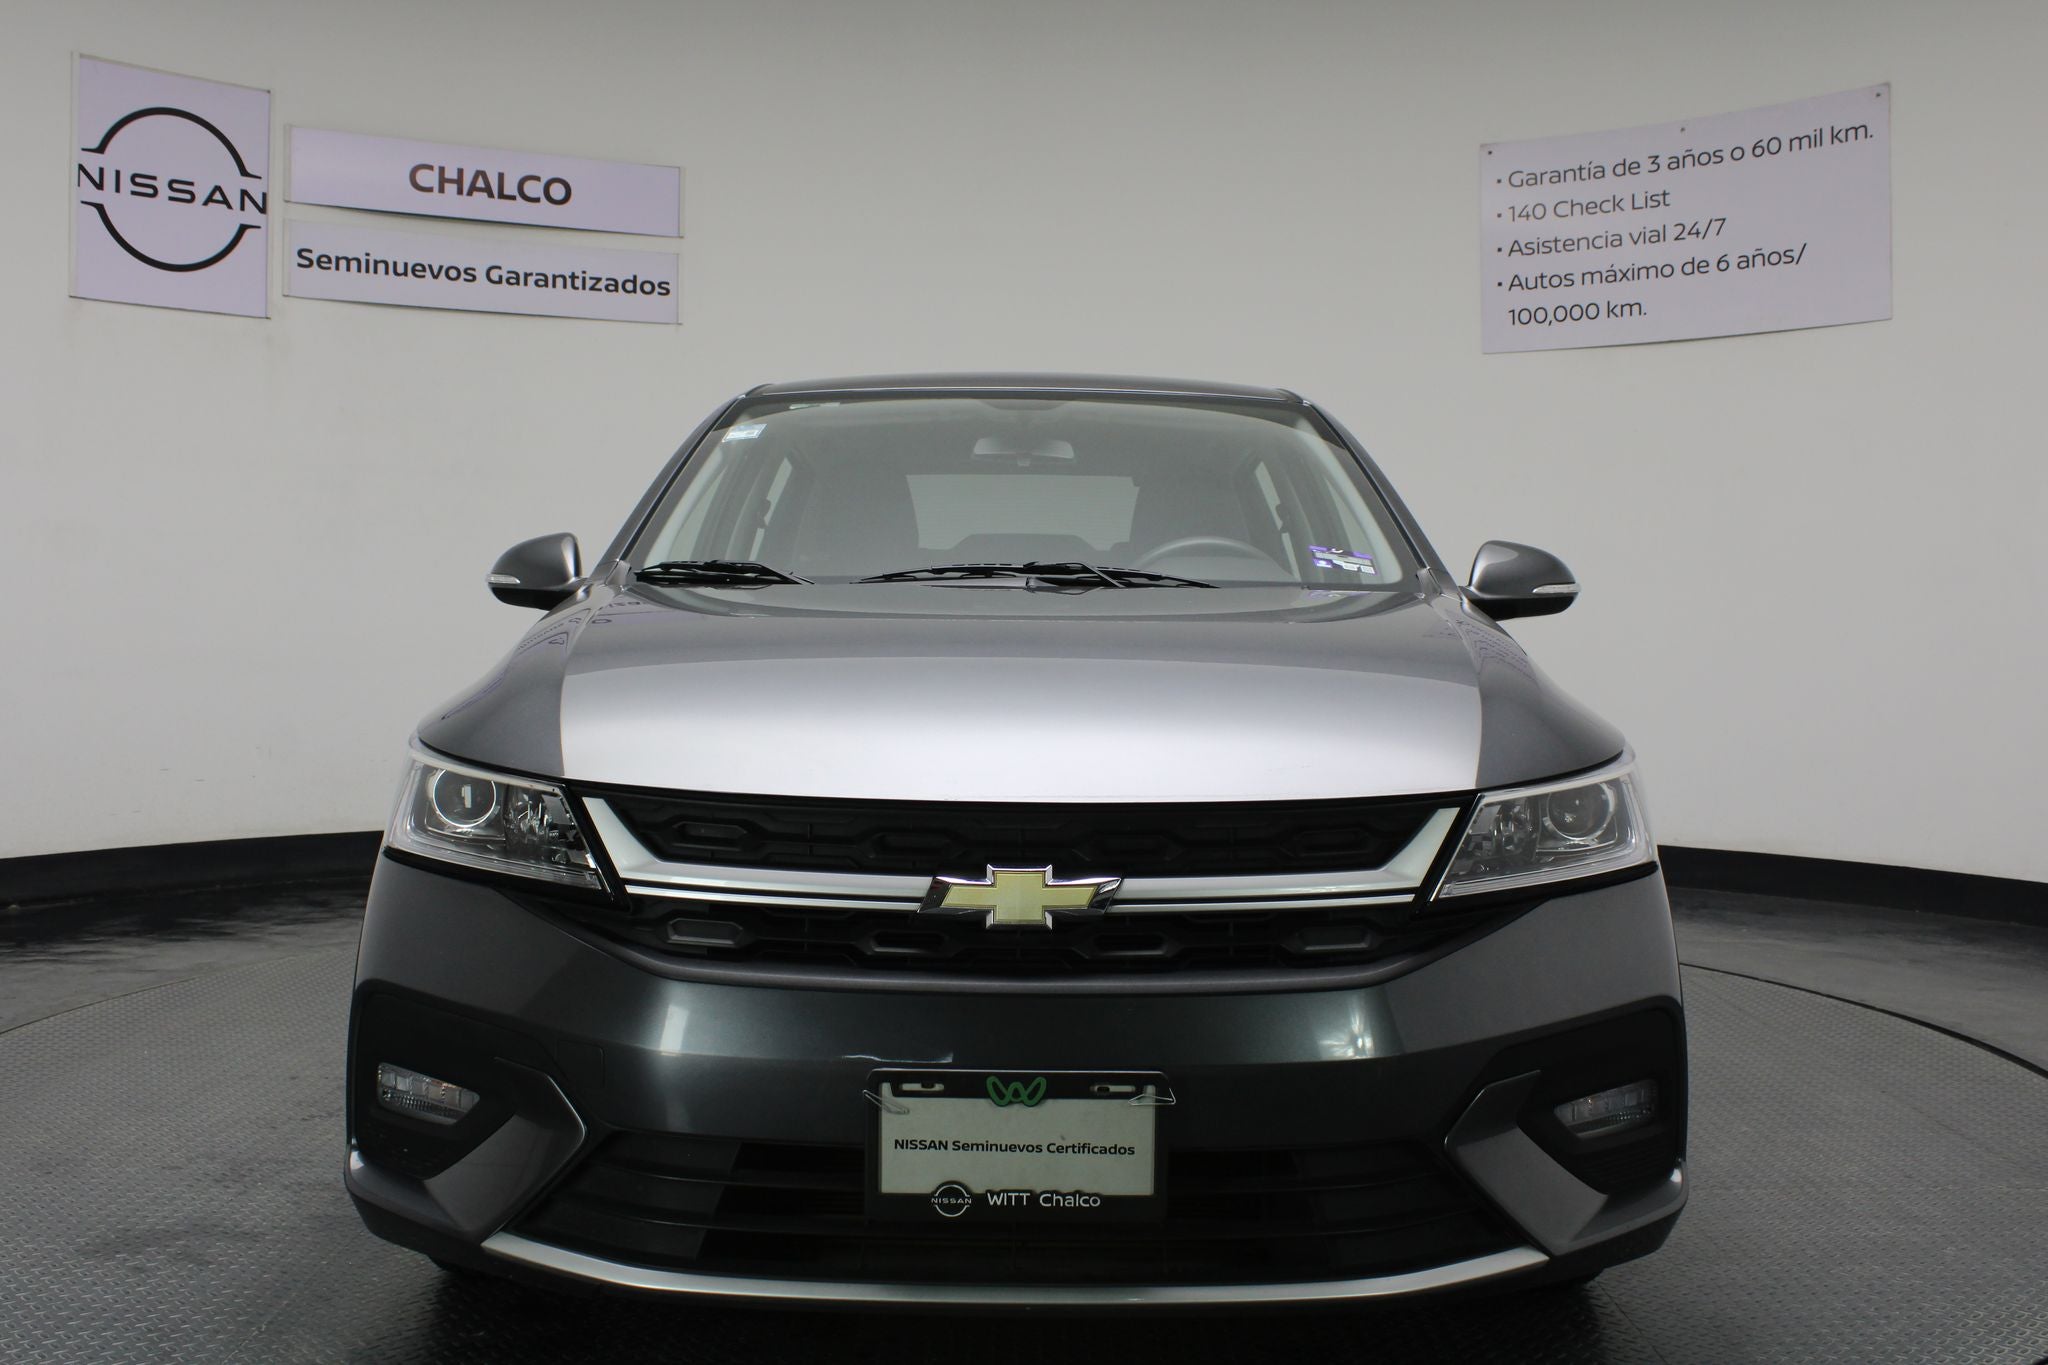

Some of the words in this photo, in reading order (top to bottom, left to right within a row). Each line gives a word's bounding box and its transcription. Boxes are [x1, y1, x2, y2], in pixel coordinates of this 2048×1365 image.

[1508, 161, 1605, 188] Garantía
[1612, 158, 1641, 177] de
[1648, 155, 1661, 172] 3
[1667, 148, 1724, 171] años
[1730, 146, 1745, 161] o
[1751, 136, 1781, 158] 60
[1789, 128, 1823, 151] mil
[1830, 123, 1874, 145] km.
[77, 162, 267, 214] NISSAN
[409, 163, 573, 205] CHALCO
[1508, 203, 1547, 222] 140
[1553, 194, 1625, 218] Check
[1632, 189, 1670, 210] List
[1508, 229, 1623, 257] Asistencia
[1629, 224, 1667, 245] vial
[1673, 217, 1726, 241] 24/7
[296, 247, 478, 283] Seminuevos
[485, 264, 671, 297] Garantizados
[1508, 271, 1574, 292] Autos
[1581, 259, 1675, 285] máximo
[1681, 256, 1709, 275] de
[1717, 254, 1729, 272] 6
[1737, 243, 1807, 269] años/
[1508, 303, 1599, 327] 100,000
[1607, 300, 1647, 319] km.
[894, 1139, 948, 1151] NISSAN
[952, 1141, 1043, 1153] Seminuevos
[1047, 1142, 1135, 1156] Certificados
[987, 1193, 1030, 1206] WITT
[1039, 1193, 1100, 1208] Chalco
